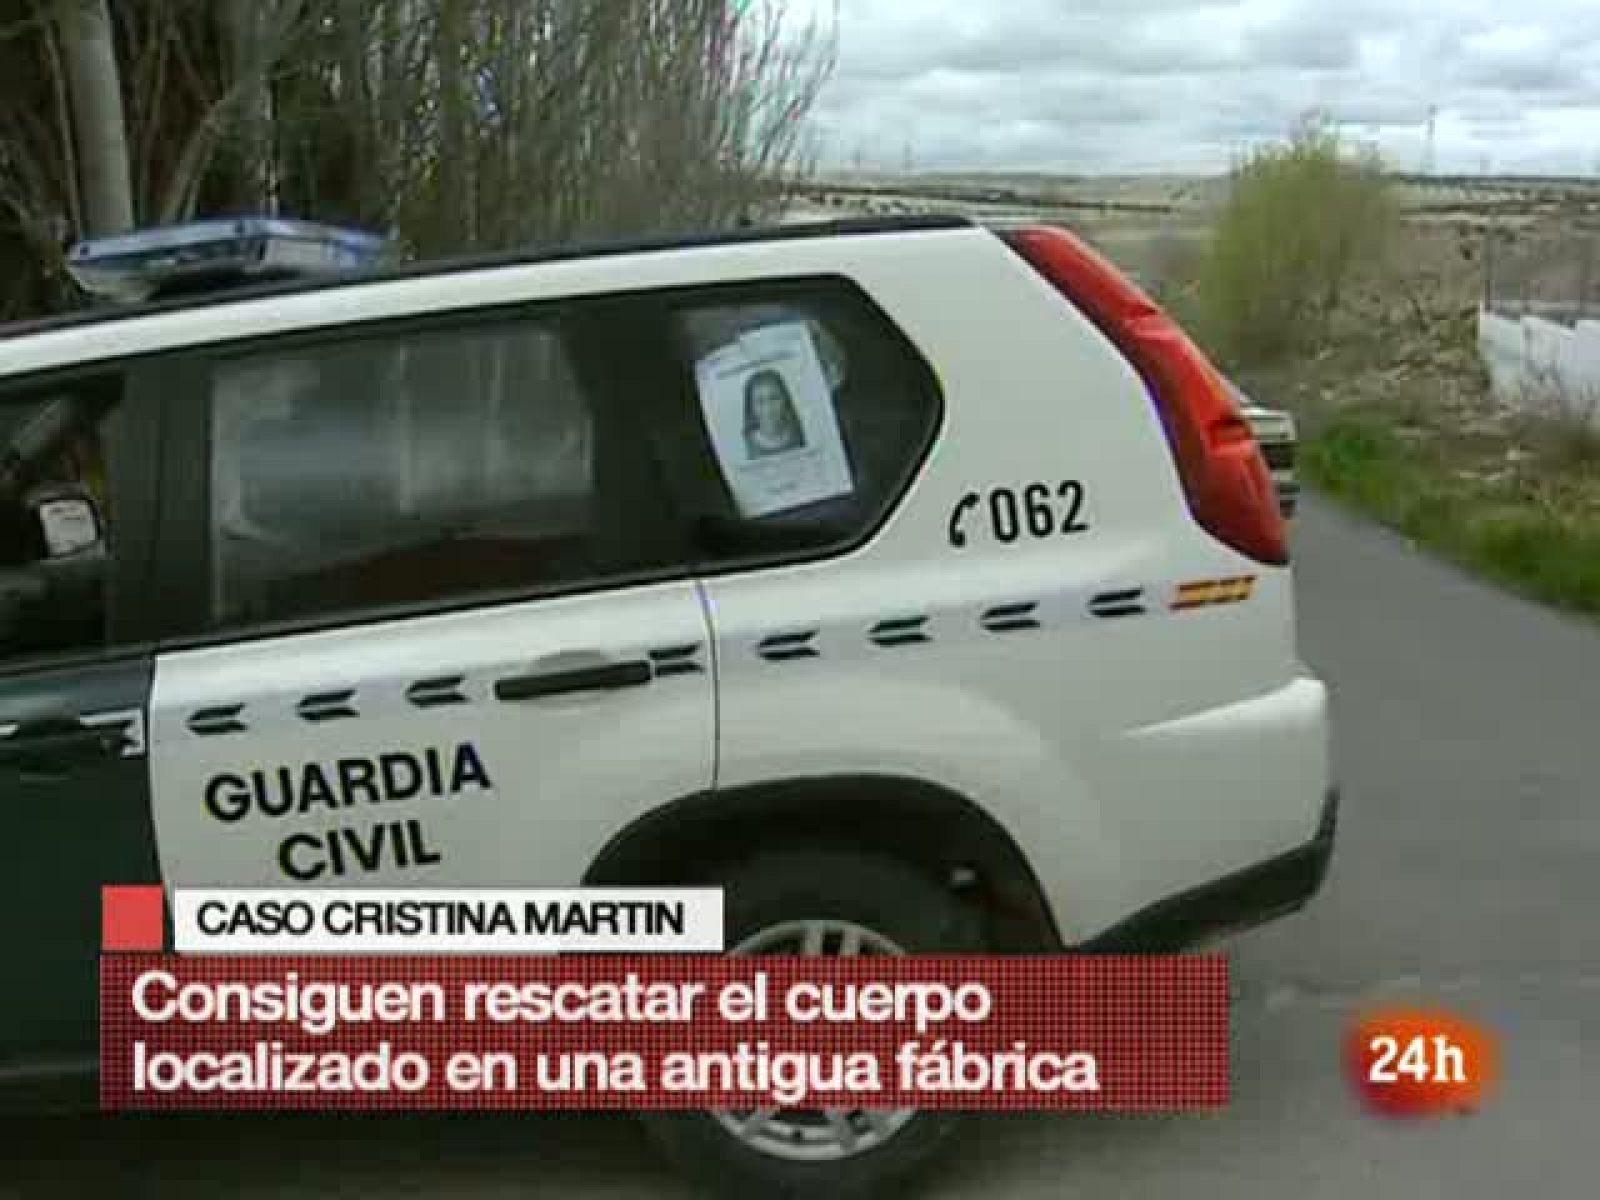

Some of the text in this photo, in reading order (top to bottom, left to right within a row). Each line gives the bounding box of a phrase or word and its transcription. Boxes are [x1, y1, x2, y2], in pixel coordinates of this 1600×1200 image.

[990, 480, 1088, 542] 062
[204, 742, 492, 821] GUARDIA
[278, 820, 441, 881] CIVIL
